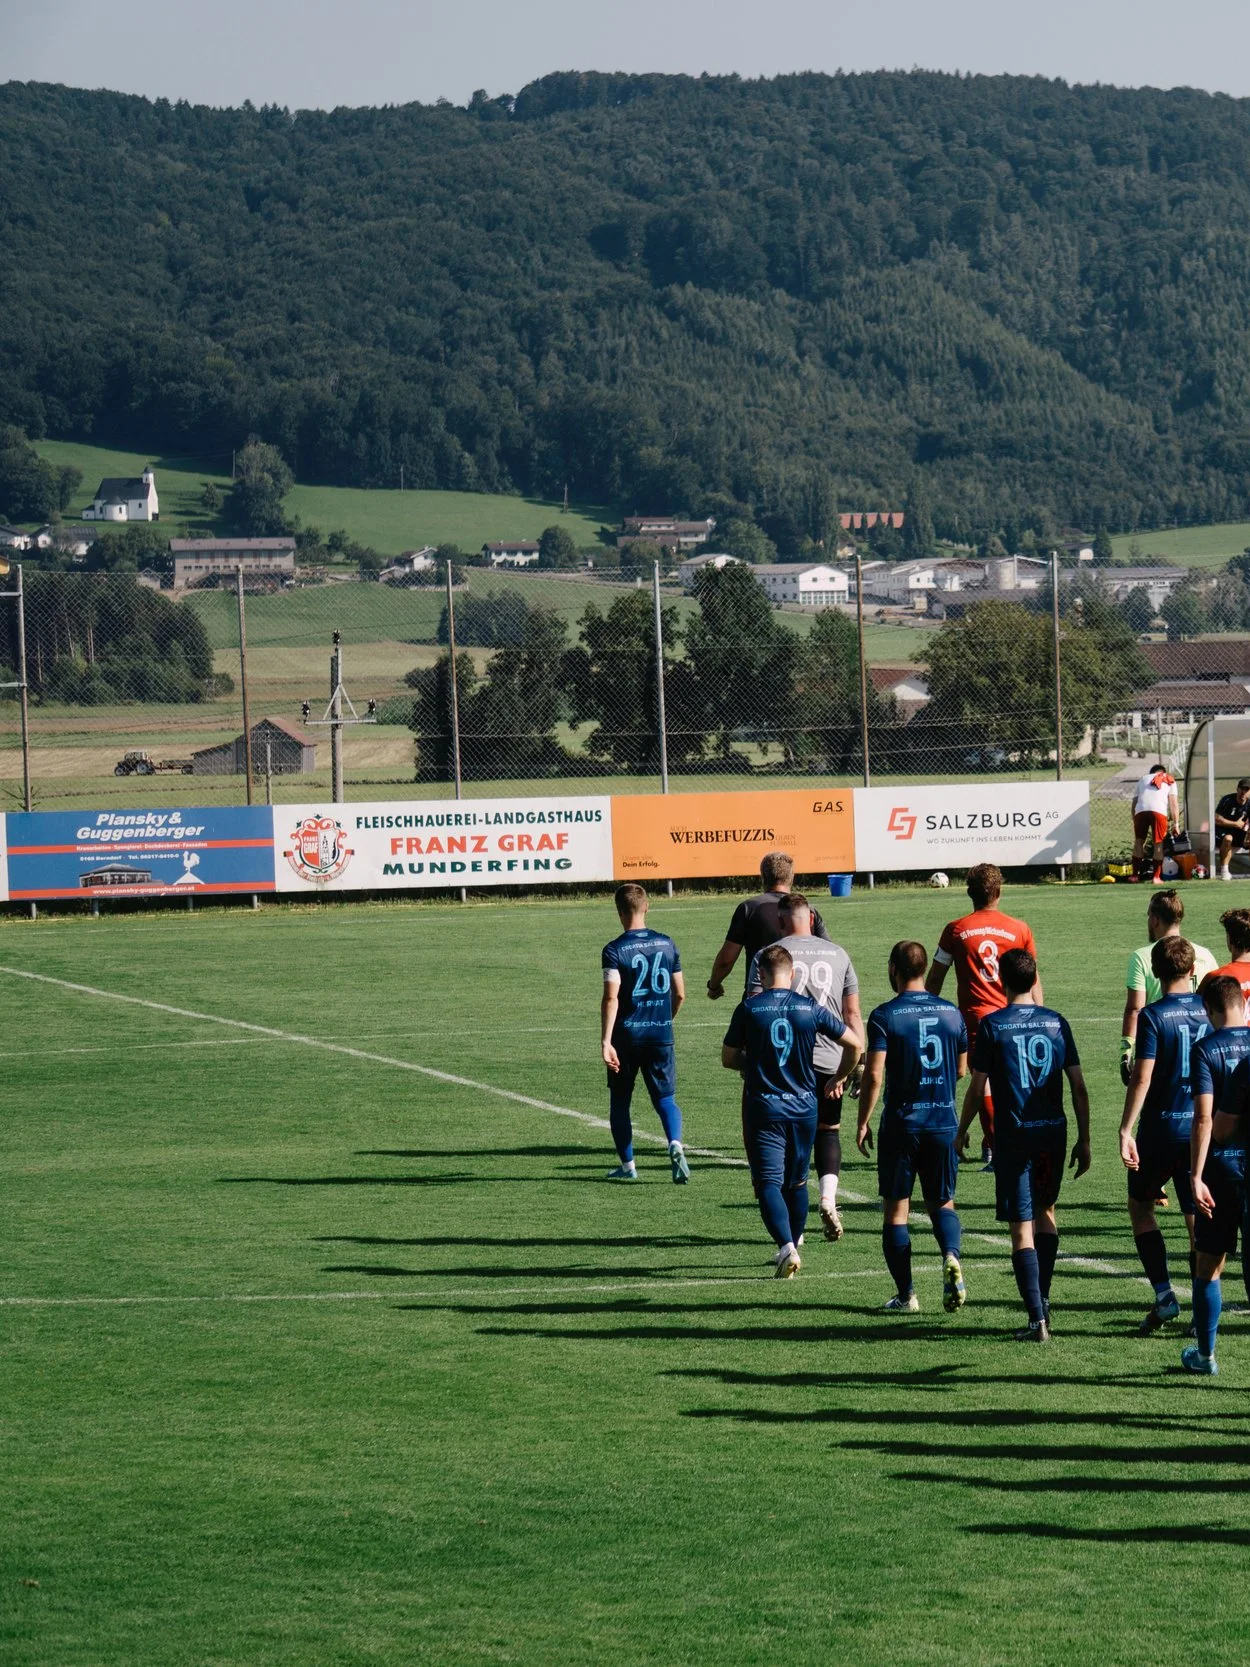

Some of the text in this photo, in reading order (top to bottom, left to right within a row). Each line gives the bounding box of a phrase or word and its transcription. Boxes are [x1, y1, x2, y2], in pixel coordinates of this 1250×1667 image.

[96, 812, 182, 827] Plansky &
[356, 810, 602, 829] FLEISCHHAUEREI-LANDGASTHAUS
[926, 811, 1059, 830] SALZBURG AG
[76, 824, 205, 842] Guggenberger
[670, 828, 775, 845] WERBEFUZZIS
[390, 832, 569, 856] FRANZ GRAF
[382, 858, 573, 876] MUNDERFING
[978, 940, 1000, 983] 3
[632, 951, 670, 996] 26
[893, 1008, 921, 1016] CROATIA
[1164, 1010, 1188, 1018] CROATIA
[770, 1018, 794, 1066] 9
[918, 1018, 943, 1070] 5
[1012, 1034, 1052, 1088] 19
